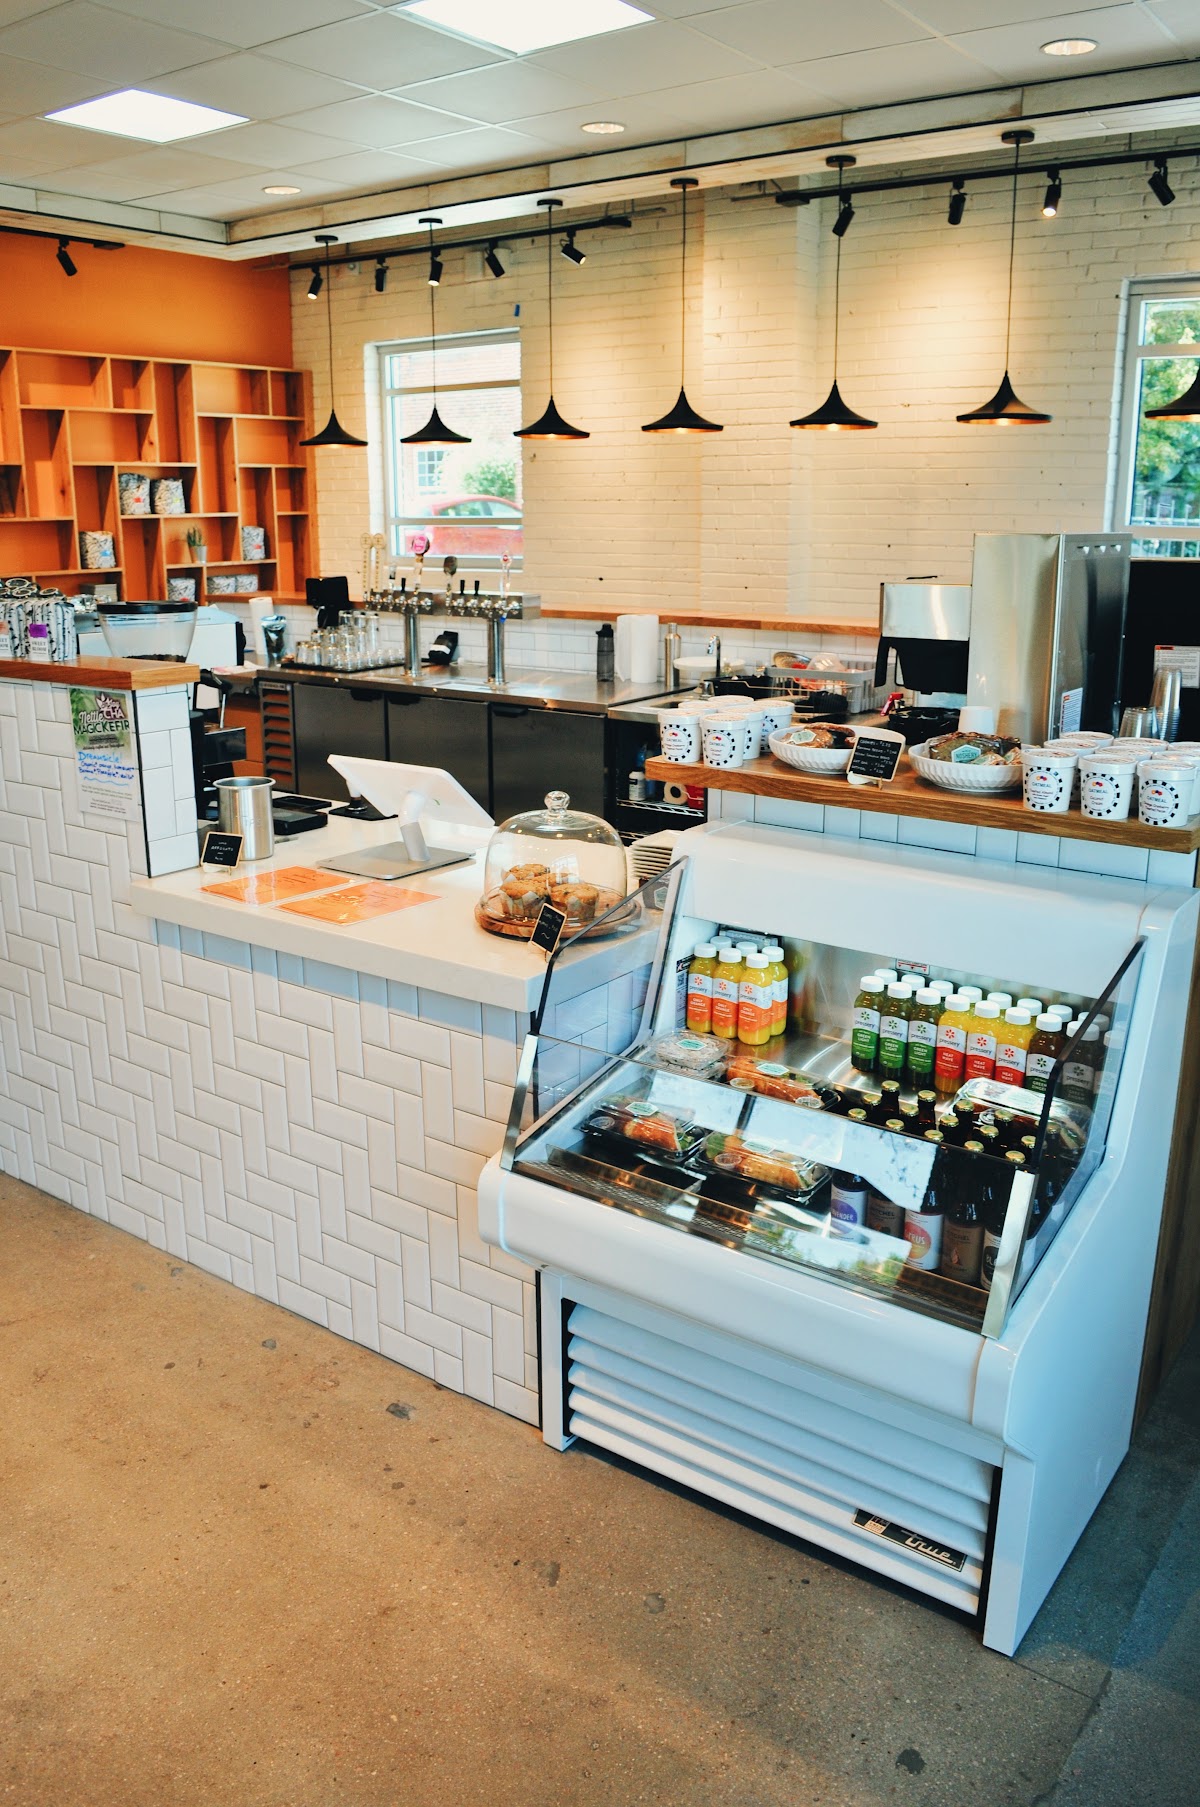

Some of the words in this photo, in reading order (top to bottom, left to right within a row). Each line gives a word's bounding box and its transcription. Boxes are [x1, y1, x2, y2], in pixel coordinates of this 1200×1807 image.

[78, 710, 104, 724] Nettle
[1147, 795, 1167, 804] OATMEAL
[714, 990, 732, 998] pressery
[740, 994, 757, 1002] pressery
[854, 1019, 876, 1029] pressery
[882, 1028, 903, 1038] pressery
[911, 1033, 932, 1042] pressery
[940, 1038, 961, 1048] pressery
[970, 1046, 992, 1055] pressery
[998, 1057, 1020, 1067] pressery
[831, 1209, 854, 1221] AVENDER
